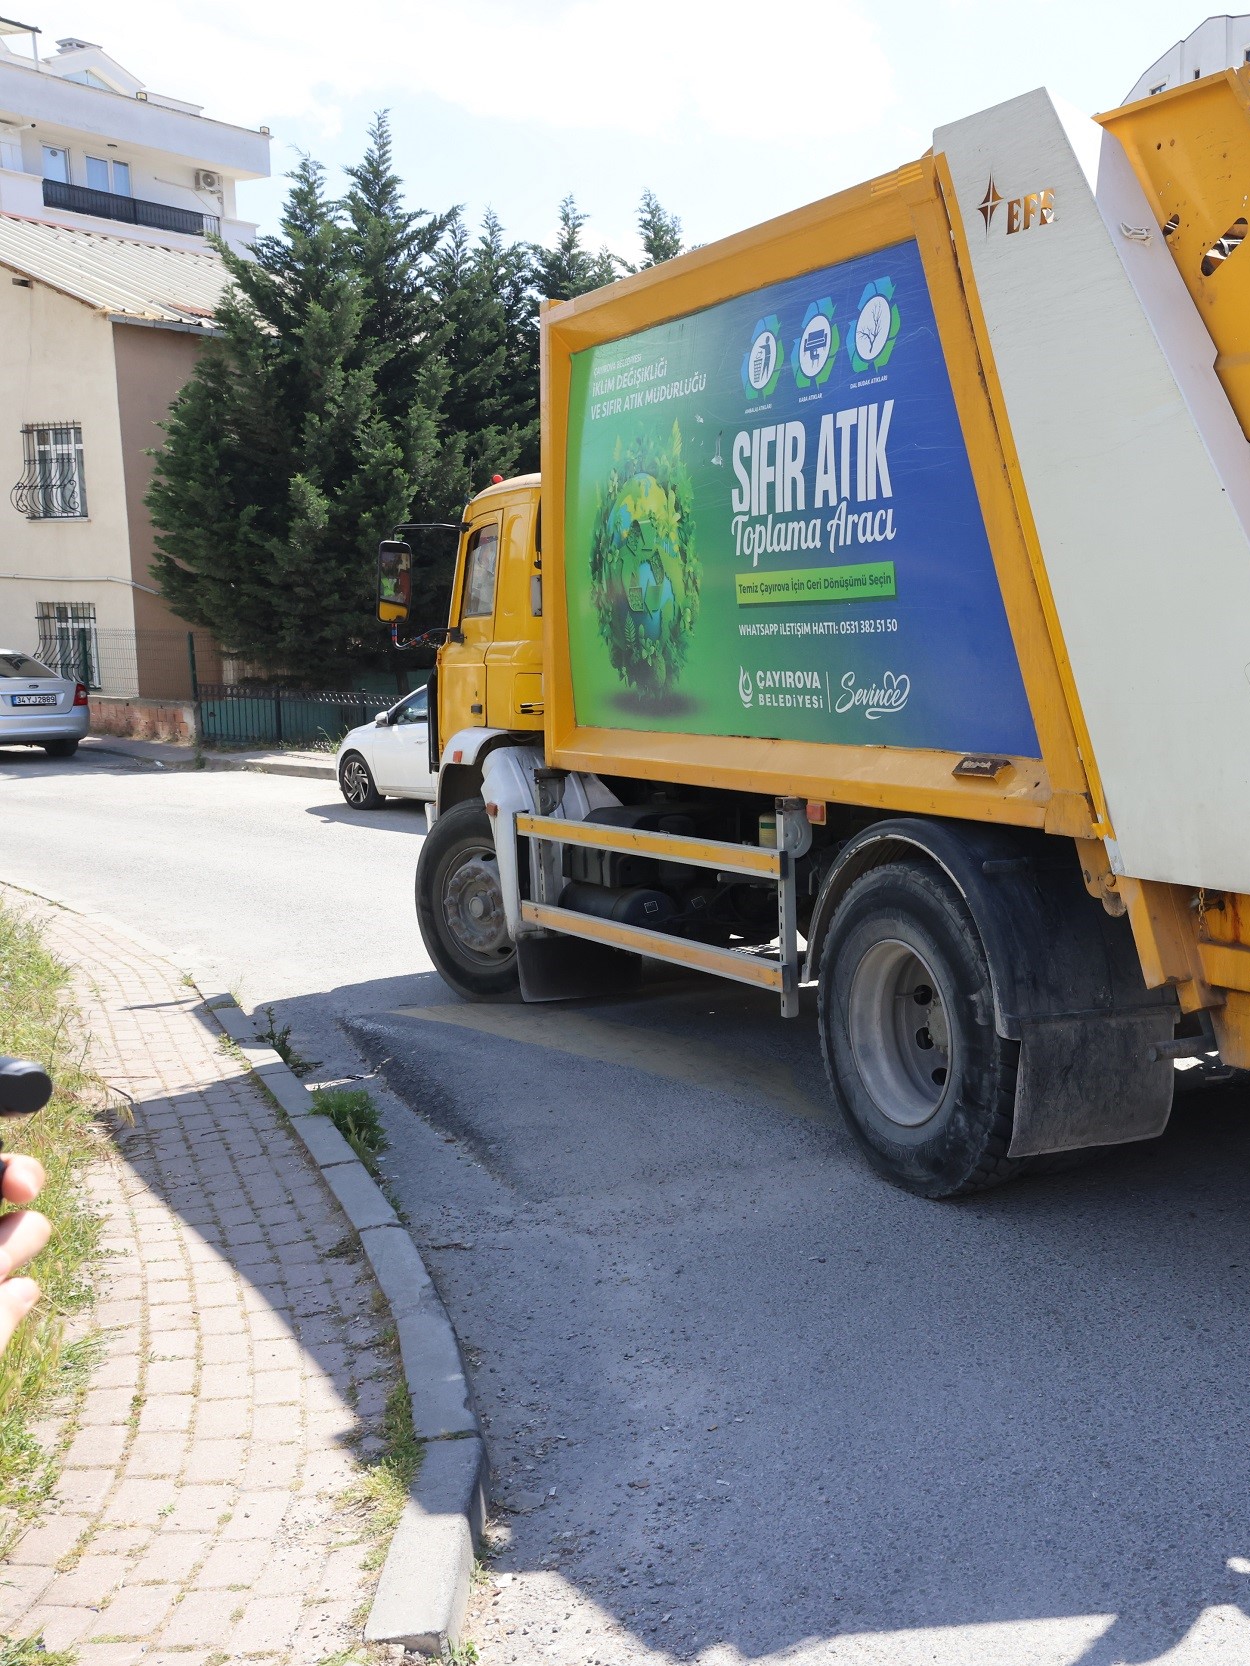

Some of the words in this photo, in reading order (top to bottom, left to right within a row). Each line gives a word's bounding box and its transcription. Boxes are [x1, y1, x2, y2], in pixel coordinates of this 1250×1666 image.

[1006, 187, 1056, 235] EFE
[590, 402, 601, 421] VE
[601, 397, 622, 418] SIFIR
[623, 390, 644, 412] ATIK
[645, 371, 707, 406] MÜDÜRLÜĞÜ
[592, 376, 615, 397] İKLİM
[616, 357, 668, 388] DEĞİŞİKLİĞİ
[857, 379, 871, 388] BUDAK
[870, 374, 888, 384] ATIKLARI
[731, 420, 806, 516] SIFIR
[814, 399, 895, 509] ATIK
[731, 513, 822, 568] Toplama
[826, 499, 897, 554] Aracı
[738, 582, 758, 594] Temiz
[759, 581, 790, 597] Çayırova
[790, 577, 805, 594] İçin
[806, 577, 822, 591] Geri
[823, 574, 867, 591] Dönüşümü
[868, 572, 892, 588] Seçin
[738, 623, 779, 636] WHATSAPP
[812, 621, 839, 635] HATTI:
[839, 620, 859, 634] 0531
[860, 619, 875, 633] 382
[876, 619, 887, 632] 51
[886, 618, 898, 632] 50
[756, 670, 822, 690] ÇAYIROVA
[835, 670, 911, 720] Sevince
[758, 693, 823, 709] BELEDİYESİ
